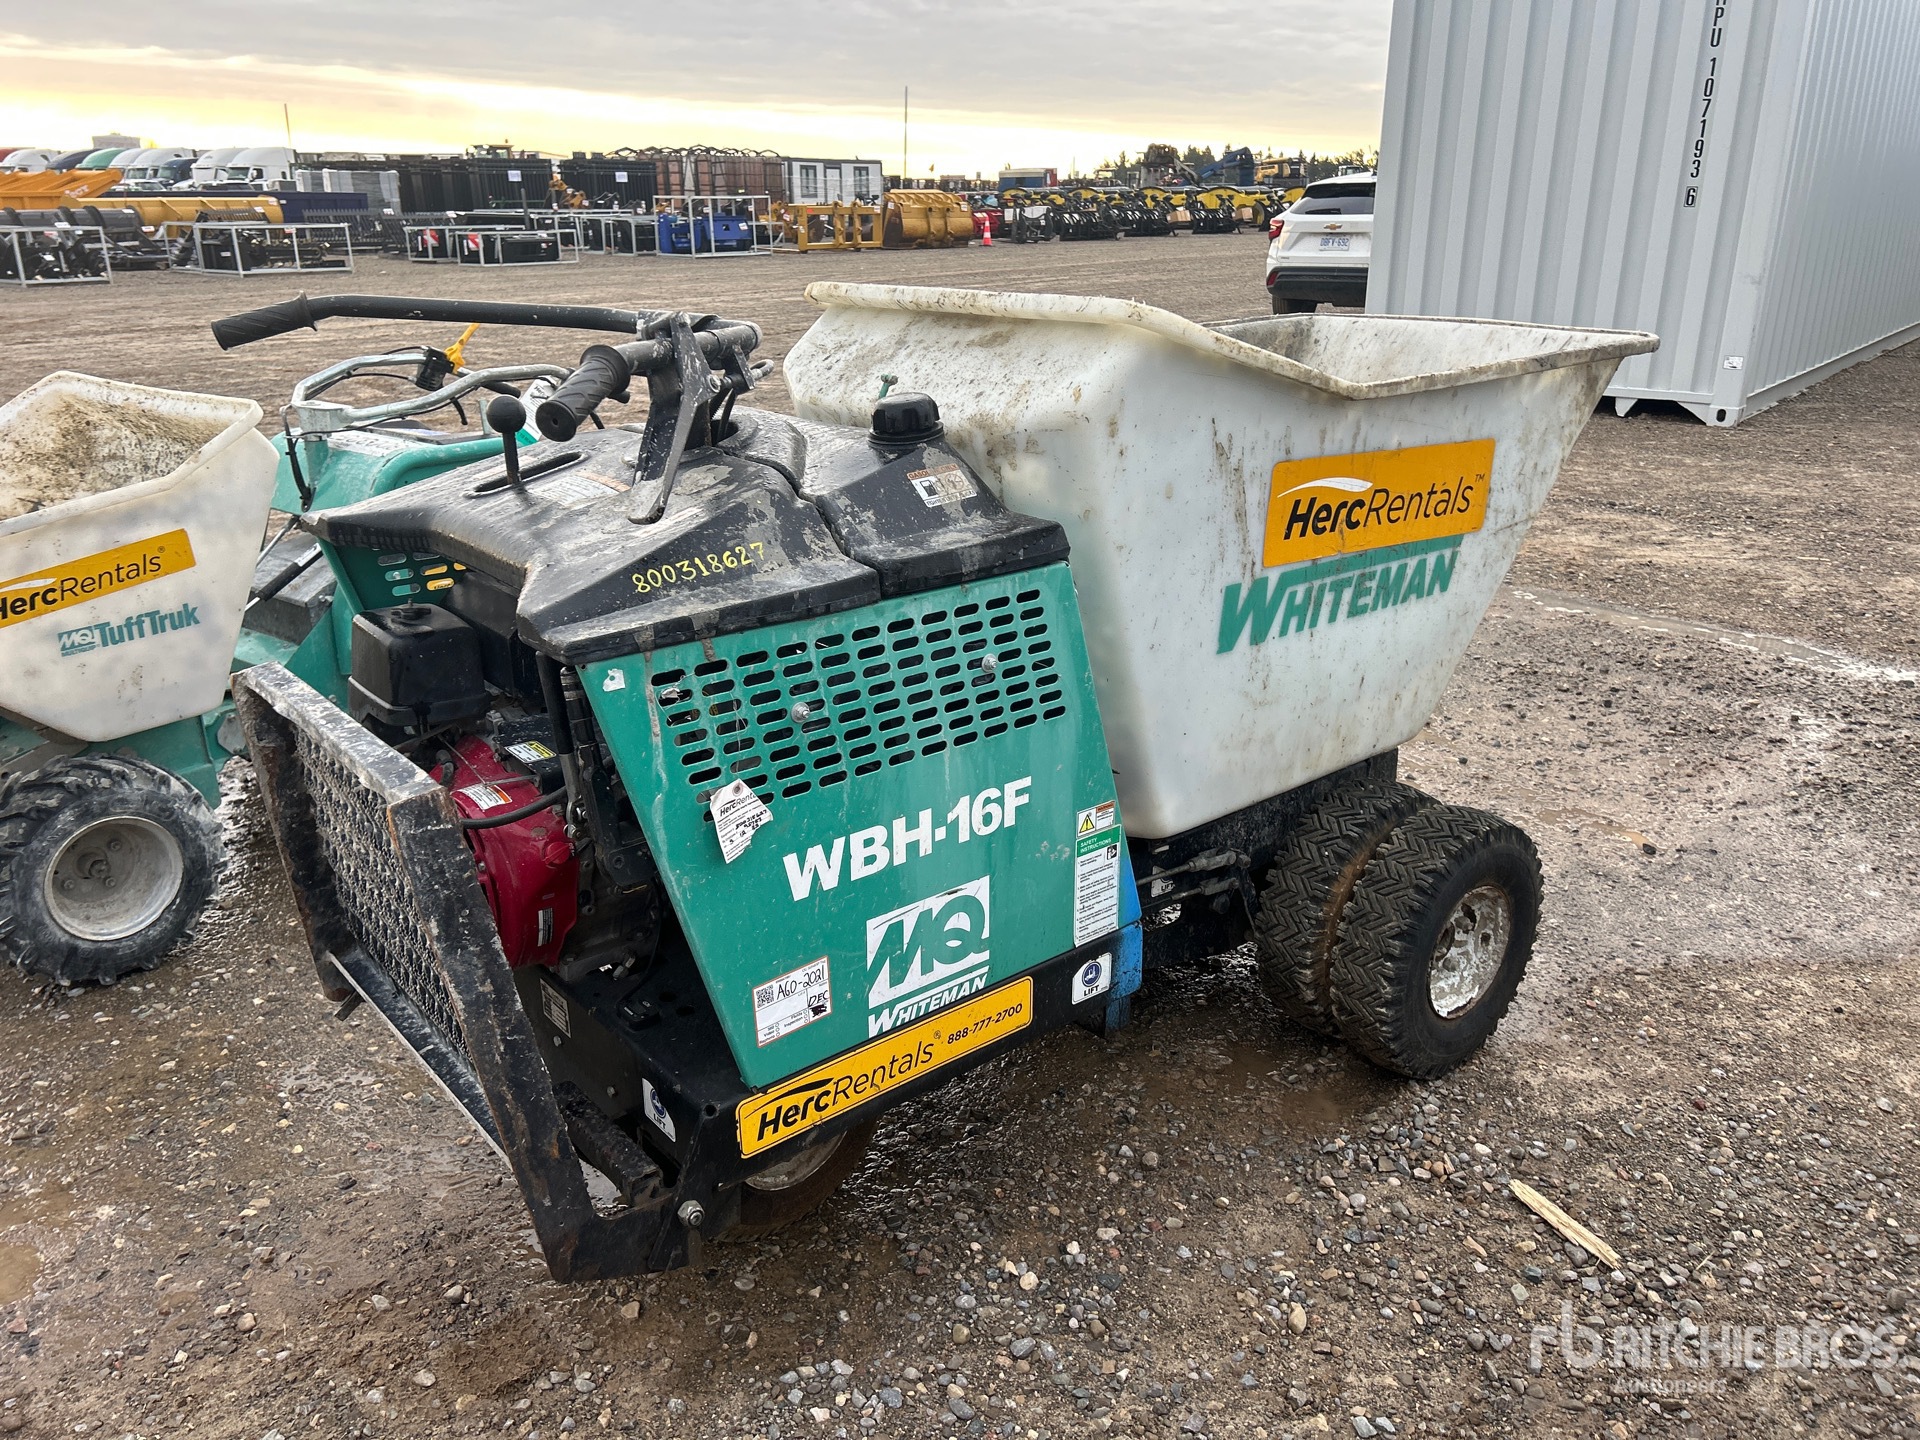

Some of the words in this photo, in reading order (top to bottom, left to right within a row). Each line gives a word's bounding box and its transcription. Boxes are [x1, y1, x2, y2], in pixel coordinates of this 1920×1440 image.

[1690, 57, 1716, 178] 107193
[1685, 187, 1696, 206] 6
[632, 542, 764, 592] 800318627
[1216, 549, 1459, 655] WHITEMAN
[94, 603, 200, 647] TuffTruk
[783, 776, 1031, 901] WBH-16F
[1080, 838, 1097, 848] SAFETY
[1080, 838, 1111, 853] INSTRUCTIONS
[866, 890, 990, 996] MQ
[808, 990, 829, 1007] DEC
[868, 970, 990, 1038] WHITEMAN
[1083, 985, 1099, 996] LIFT
[947, 1003, 1022, 1045] 888-777-2700
[653, 1113, 666, 1130] LIFT
